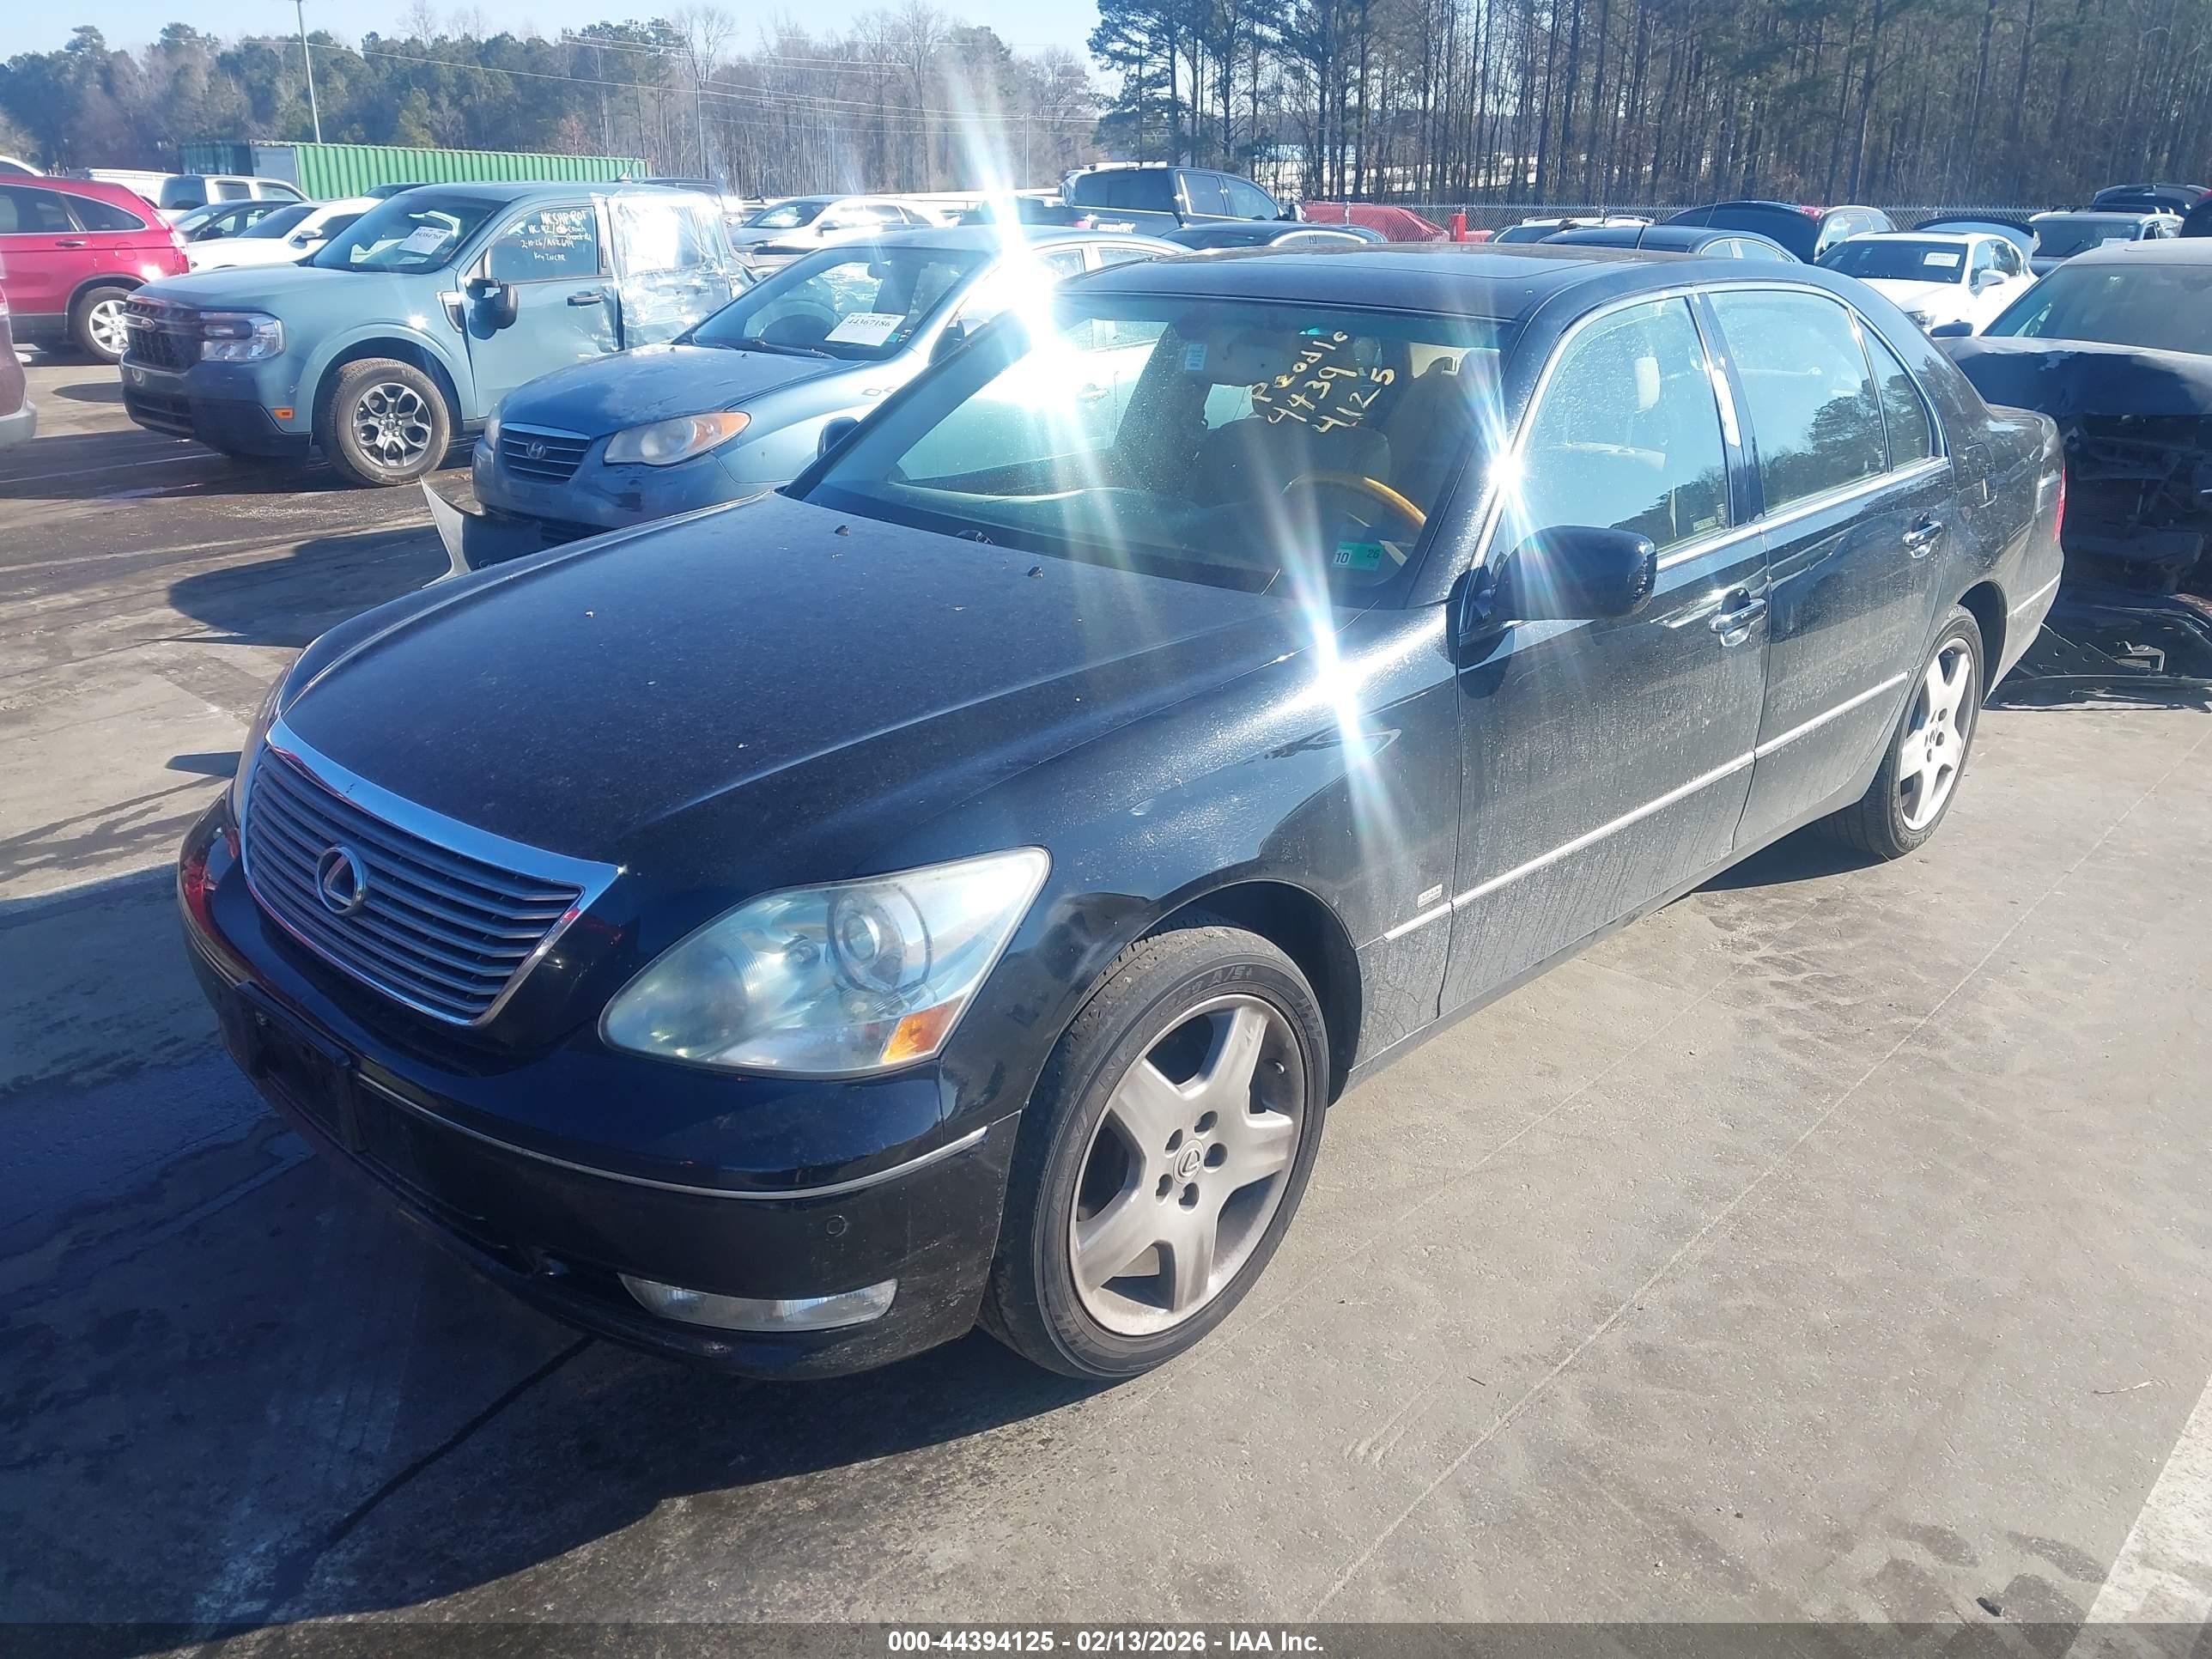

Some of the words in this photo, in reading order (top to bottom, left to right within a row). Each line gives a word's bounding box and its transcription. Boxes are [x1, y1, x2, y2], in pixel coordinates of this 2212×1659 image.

[847, 318, 891, 327] 44367186
[1267, 366, 1358, 424] 4439
[1311, 368, 1395, 433] 4125
[1335, 552, 1350, 563] 10
[1367, 549, 1380, 558] 26
